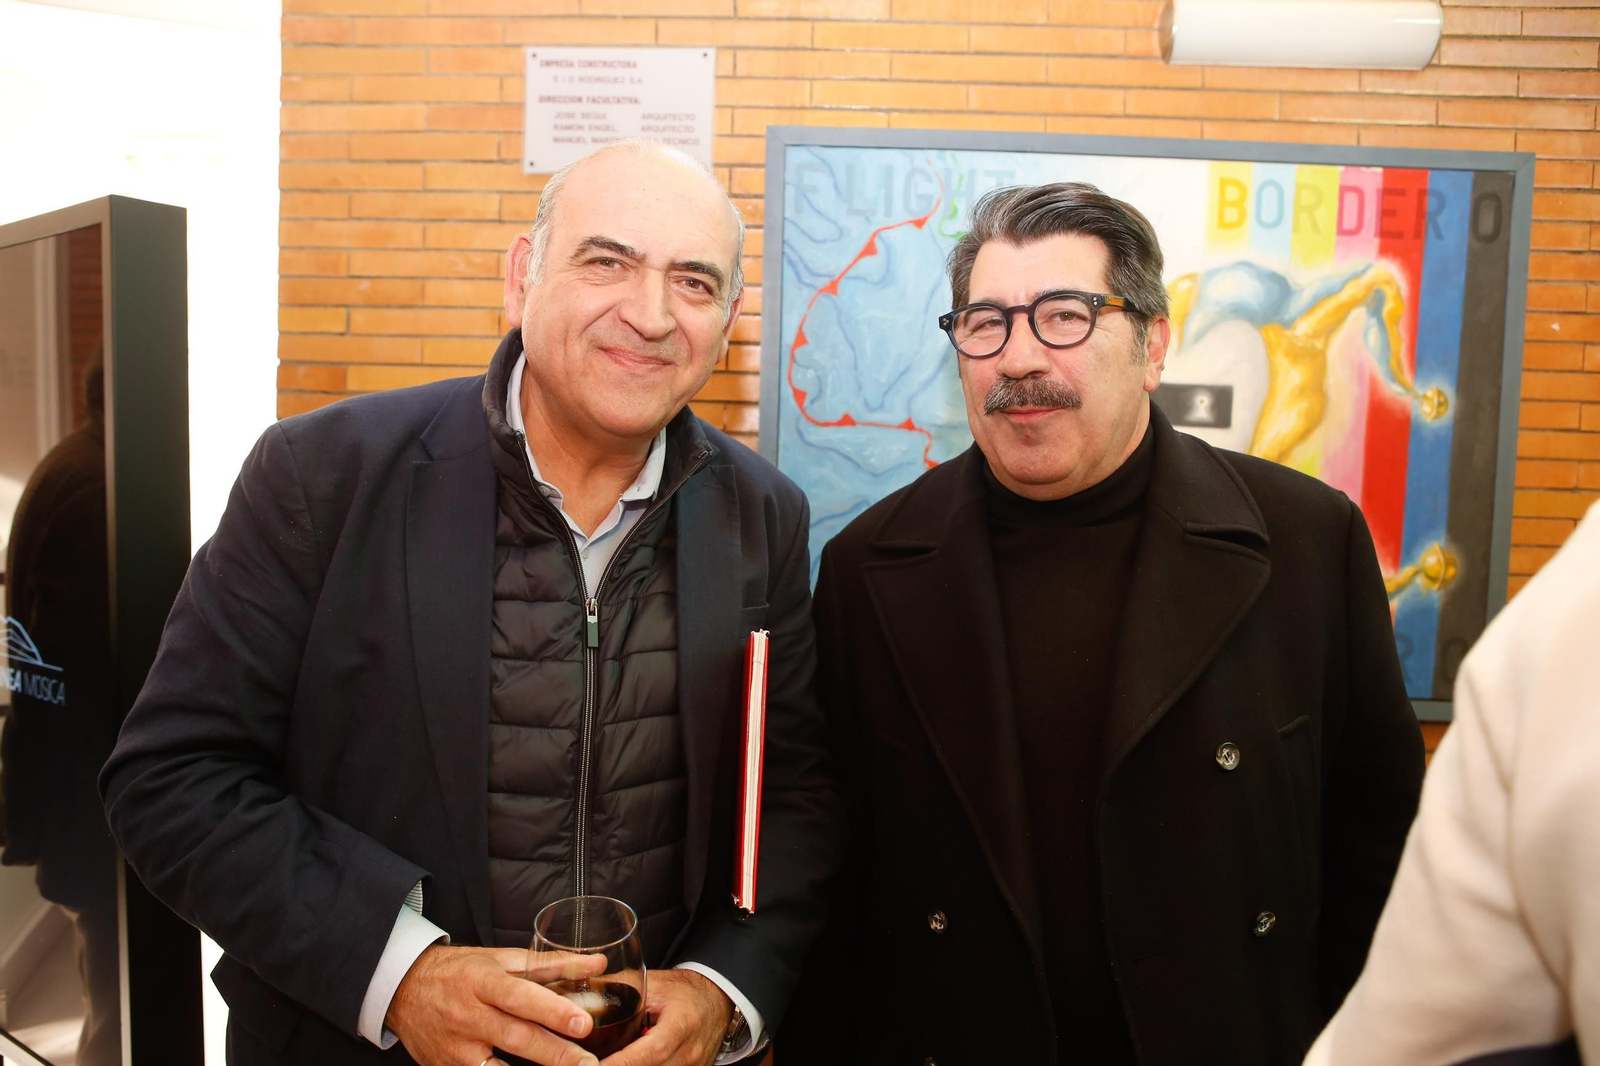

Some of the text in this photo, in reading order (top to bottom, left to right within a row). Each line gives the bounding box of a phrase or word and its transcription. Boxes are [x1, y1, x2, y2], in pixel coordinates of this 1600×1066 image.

[540, 60, 637, 68] EMPRESA CONSTRUCTORA
[553, 136, 587, 144] MANUEL
